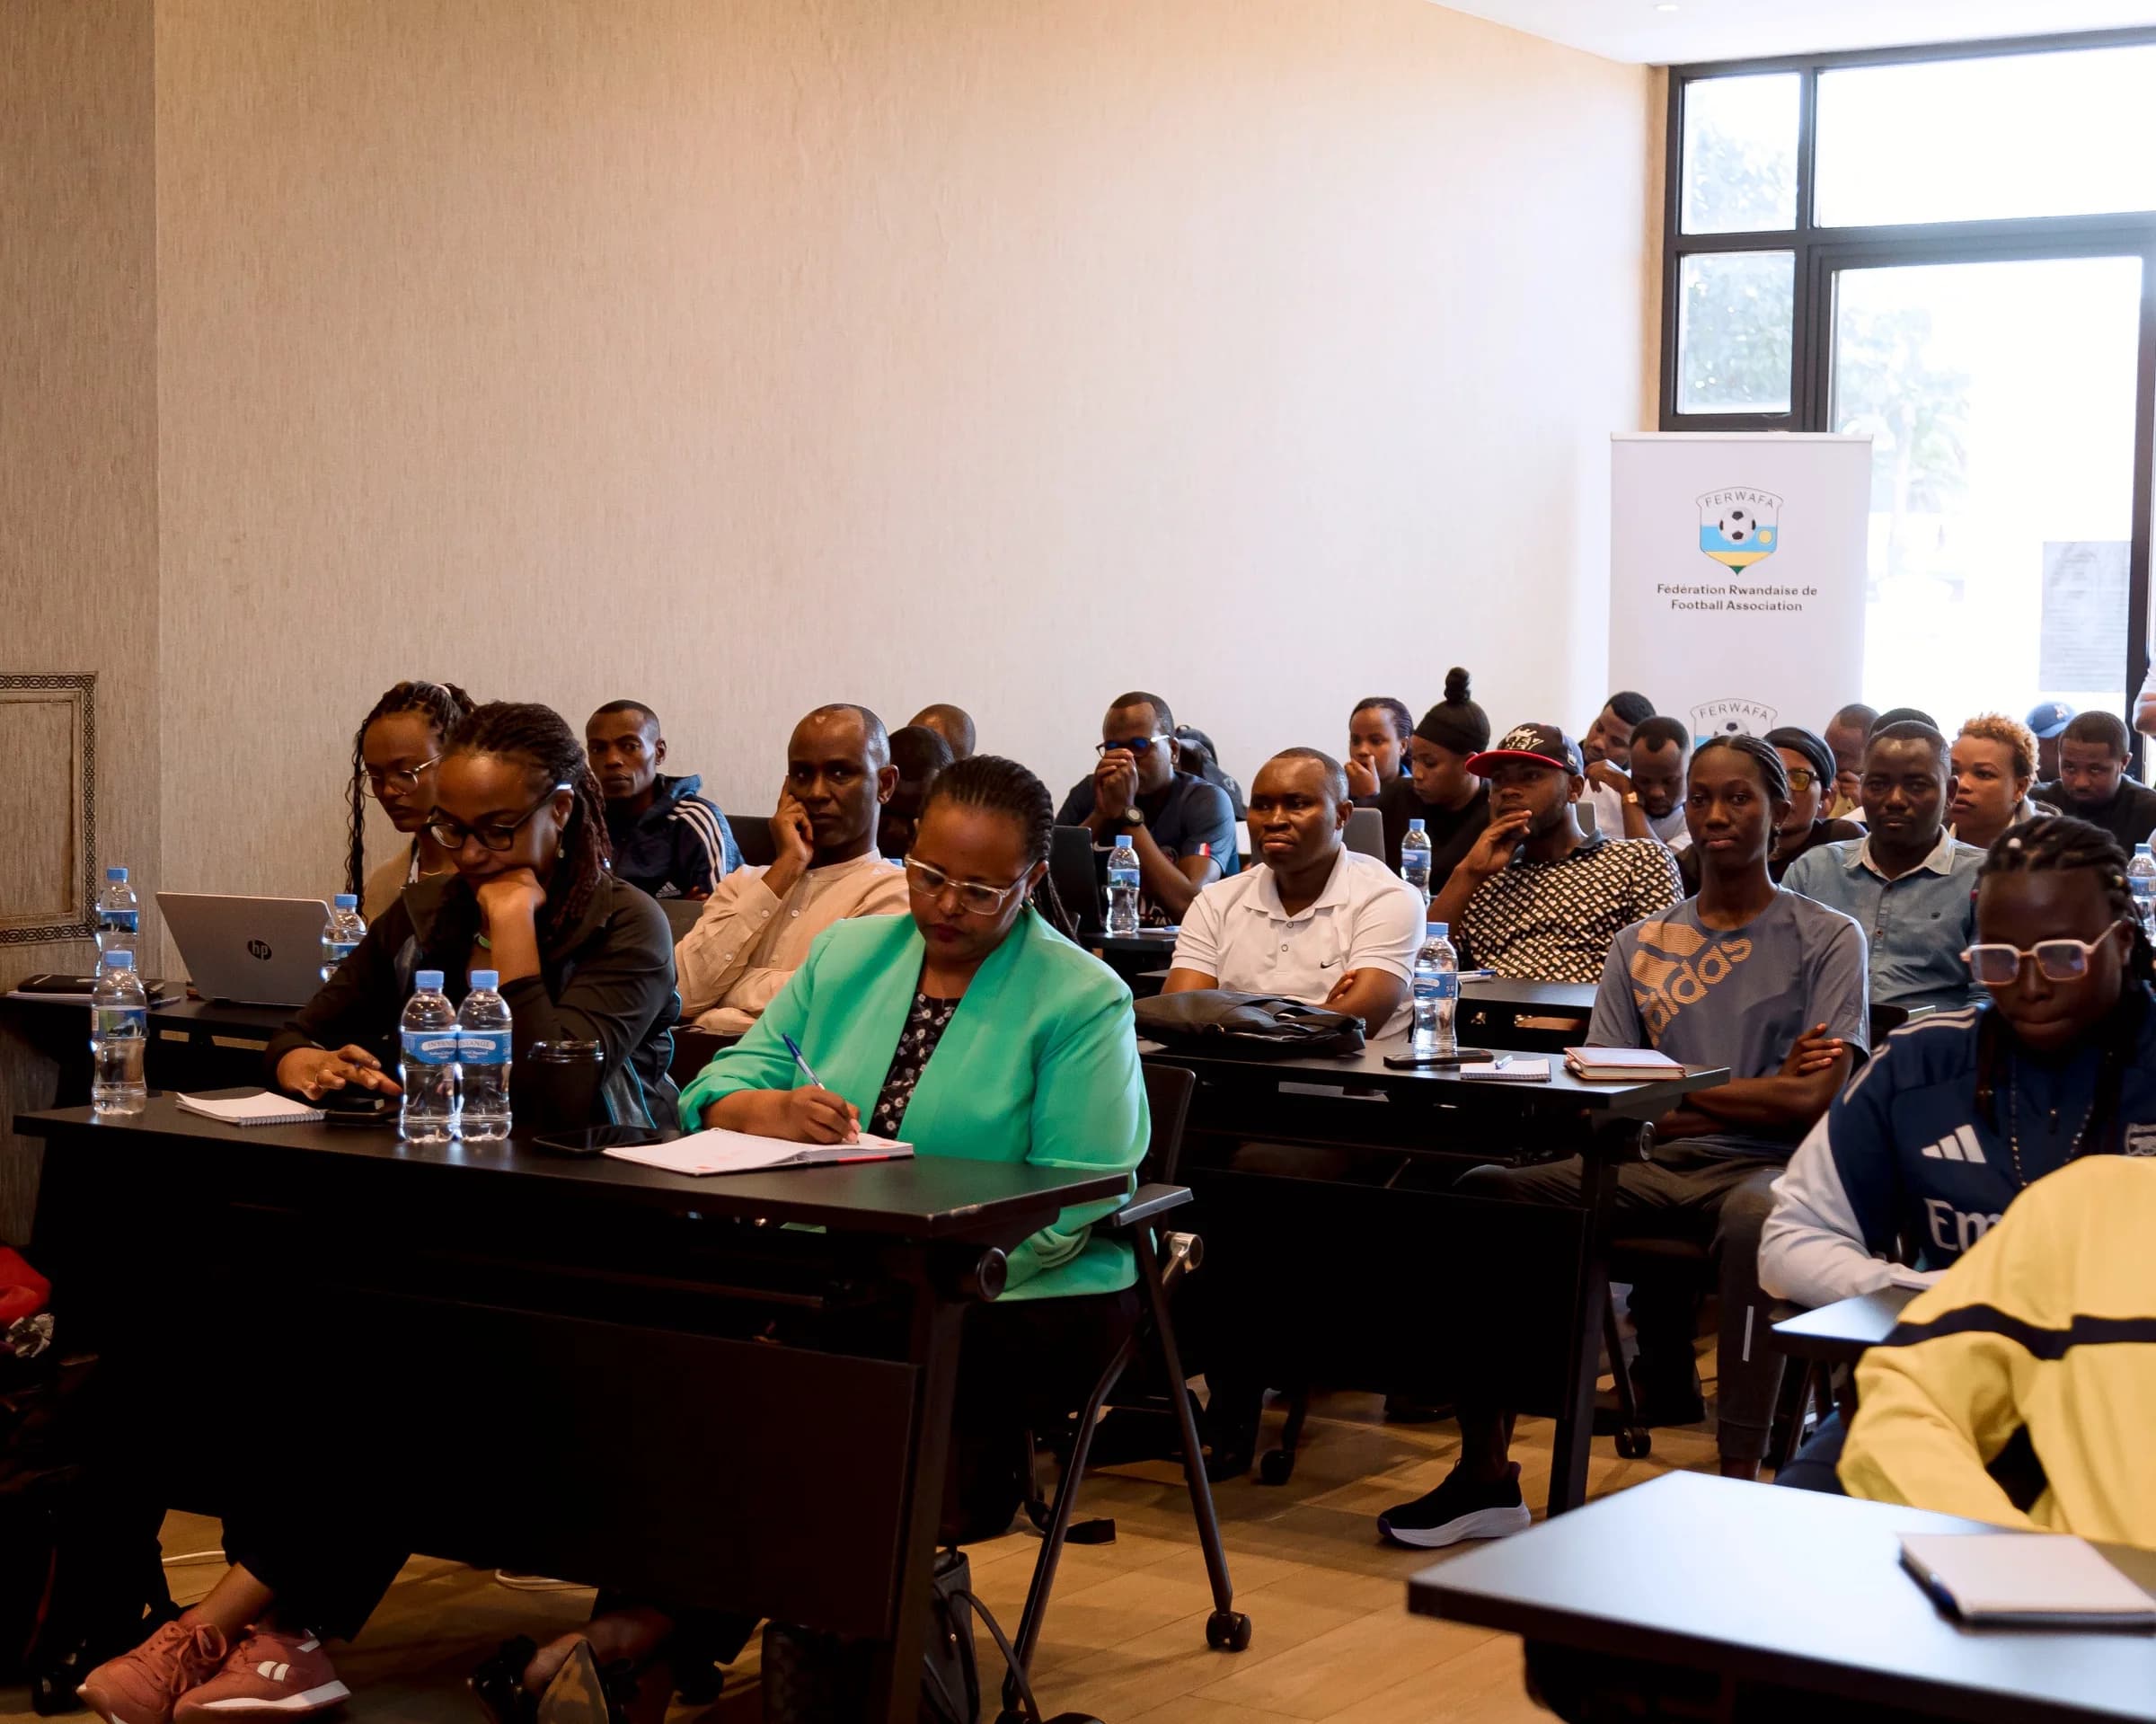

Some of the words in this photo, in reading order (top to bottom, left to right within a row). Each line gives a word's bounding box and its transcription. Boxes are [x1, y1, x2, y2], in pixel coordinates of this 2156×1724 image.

[1705, 491, 1774, 508] FERWAFA
[1728, 584, 1798, 596] Rwandaise
[1801, 585, 1818, 596] de
[1671, 598, 1724, 611] Football
[1726, 600, 1803, 612] Association
[1699, 702, 1768, 721] FERWAFA
[251, 940, 270, 961] hp
[1645, 939, 1753, 1049] didas
